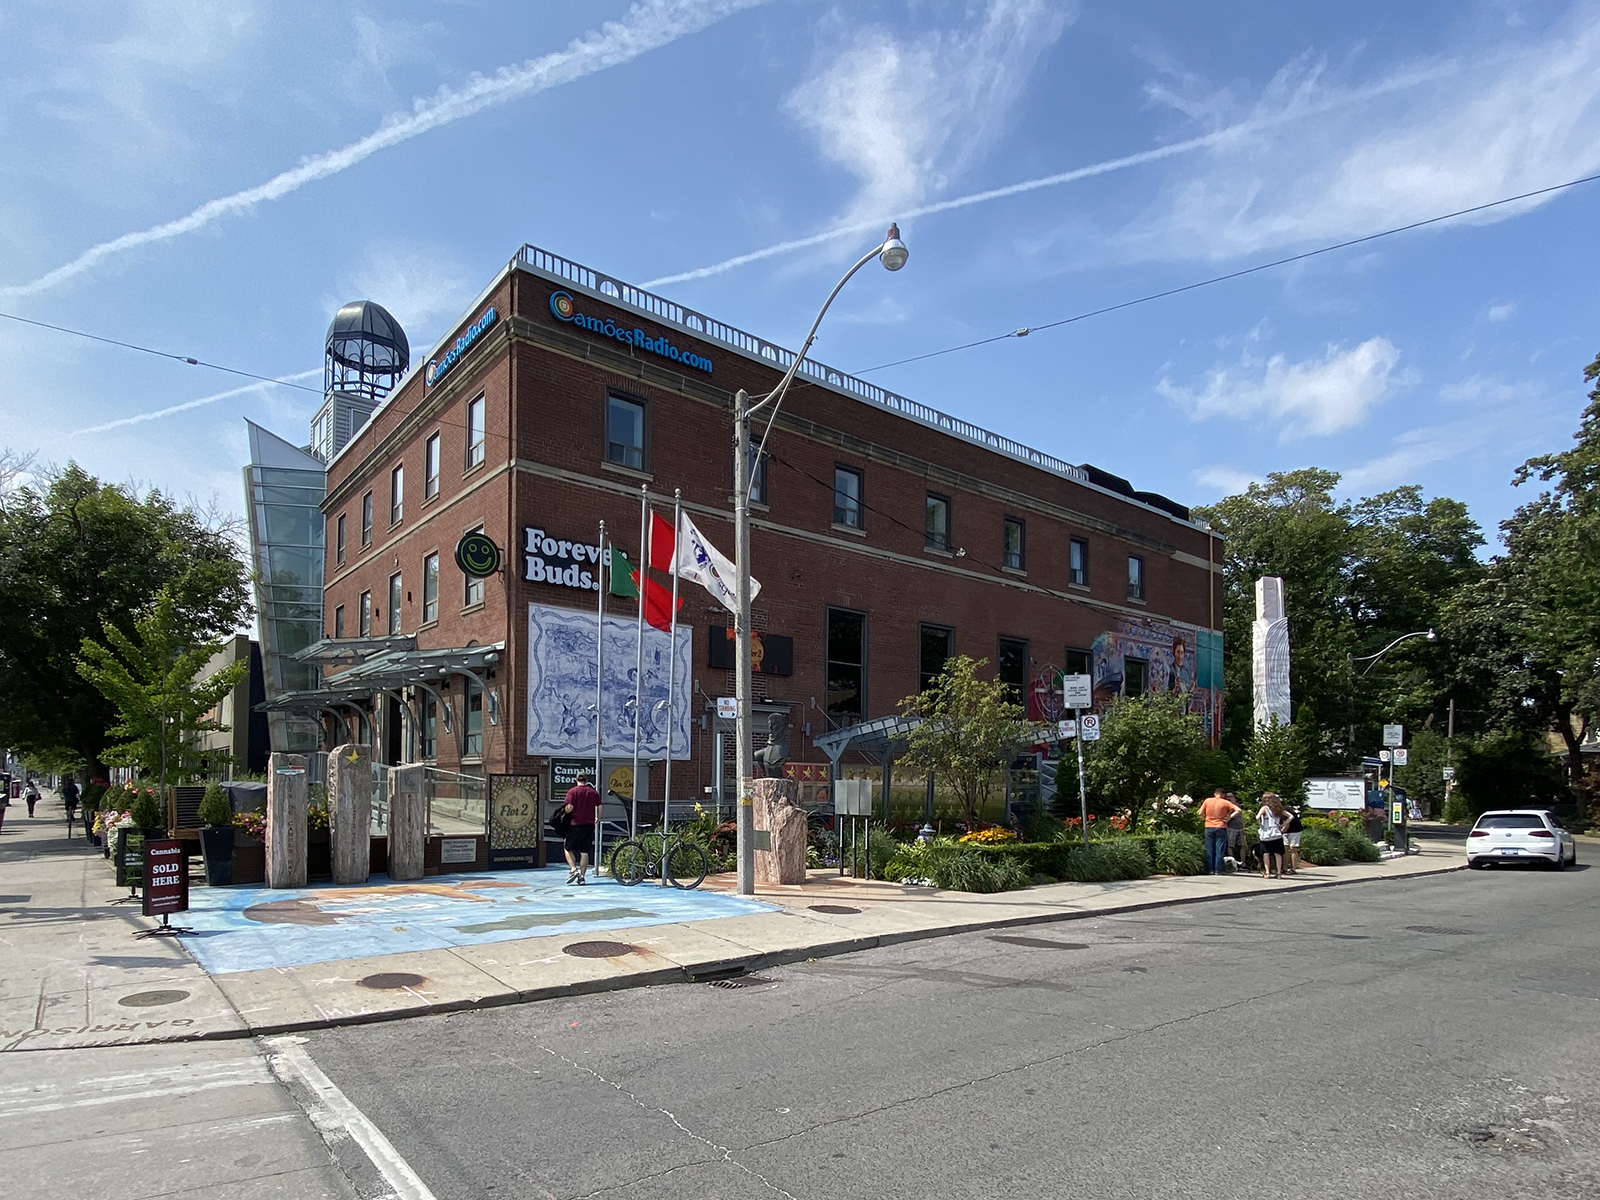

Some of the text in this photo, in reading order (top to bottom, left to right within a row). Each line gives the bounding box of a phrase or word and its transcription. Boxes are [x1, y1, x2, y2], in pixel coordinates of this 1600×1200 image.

[550, 290, 713, 373] CamõesRadio.com
[525, 527, 628, 567] Foreve
[554, 775, 577, 784] Stor
[500, 803, 529, 817] Flor 2
[152, 864, 179, 874] SOLD
[151, 875, 180, 887] HERE
[0, 1018, 195, 1040] GARRISON
